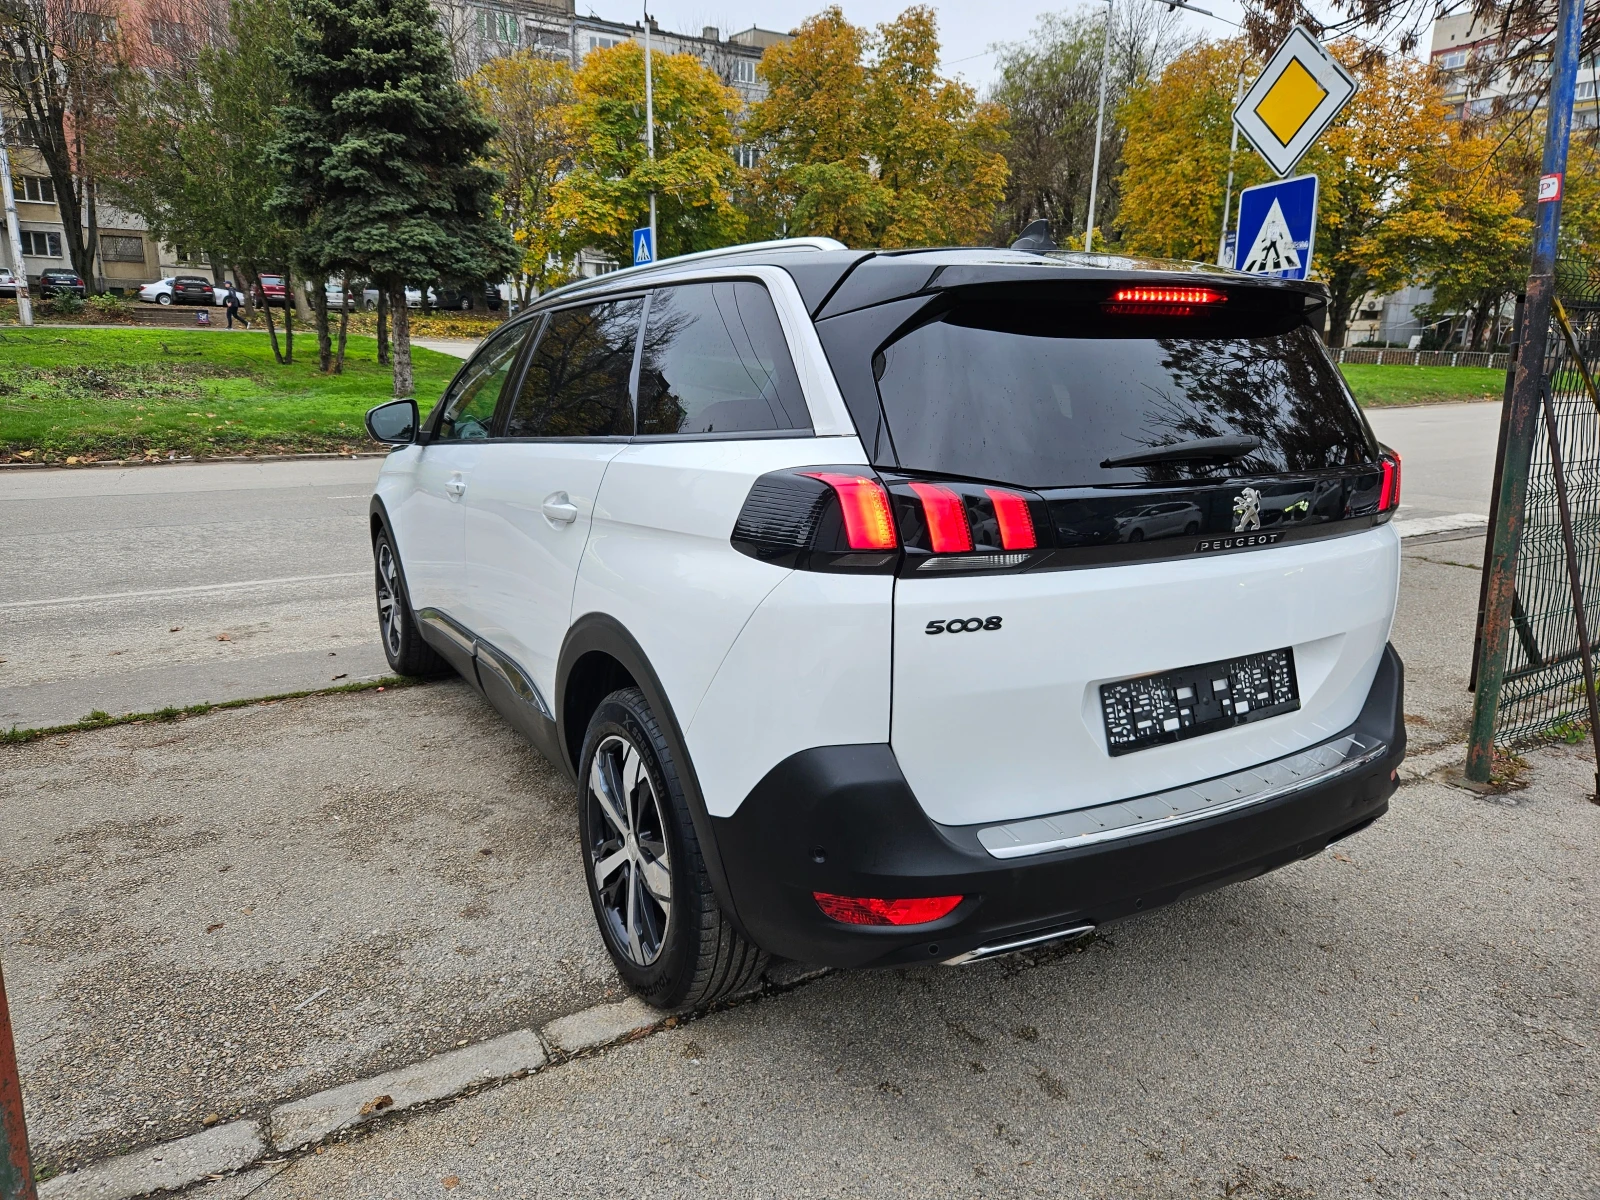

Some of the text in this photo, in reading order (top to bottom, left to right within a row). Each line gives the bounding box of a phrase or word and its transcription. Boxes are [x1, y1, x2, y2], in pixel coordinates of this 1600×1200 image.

[1200, 534, 1278, 551] PEUGEOT
[924, 615, 1003, 635] 5008
[631, 726, 654, 767] SPEED
